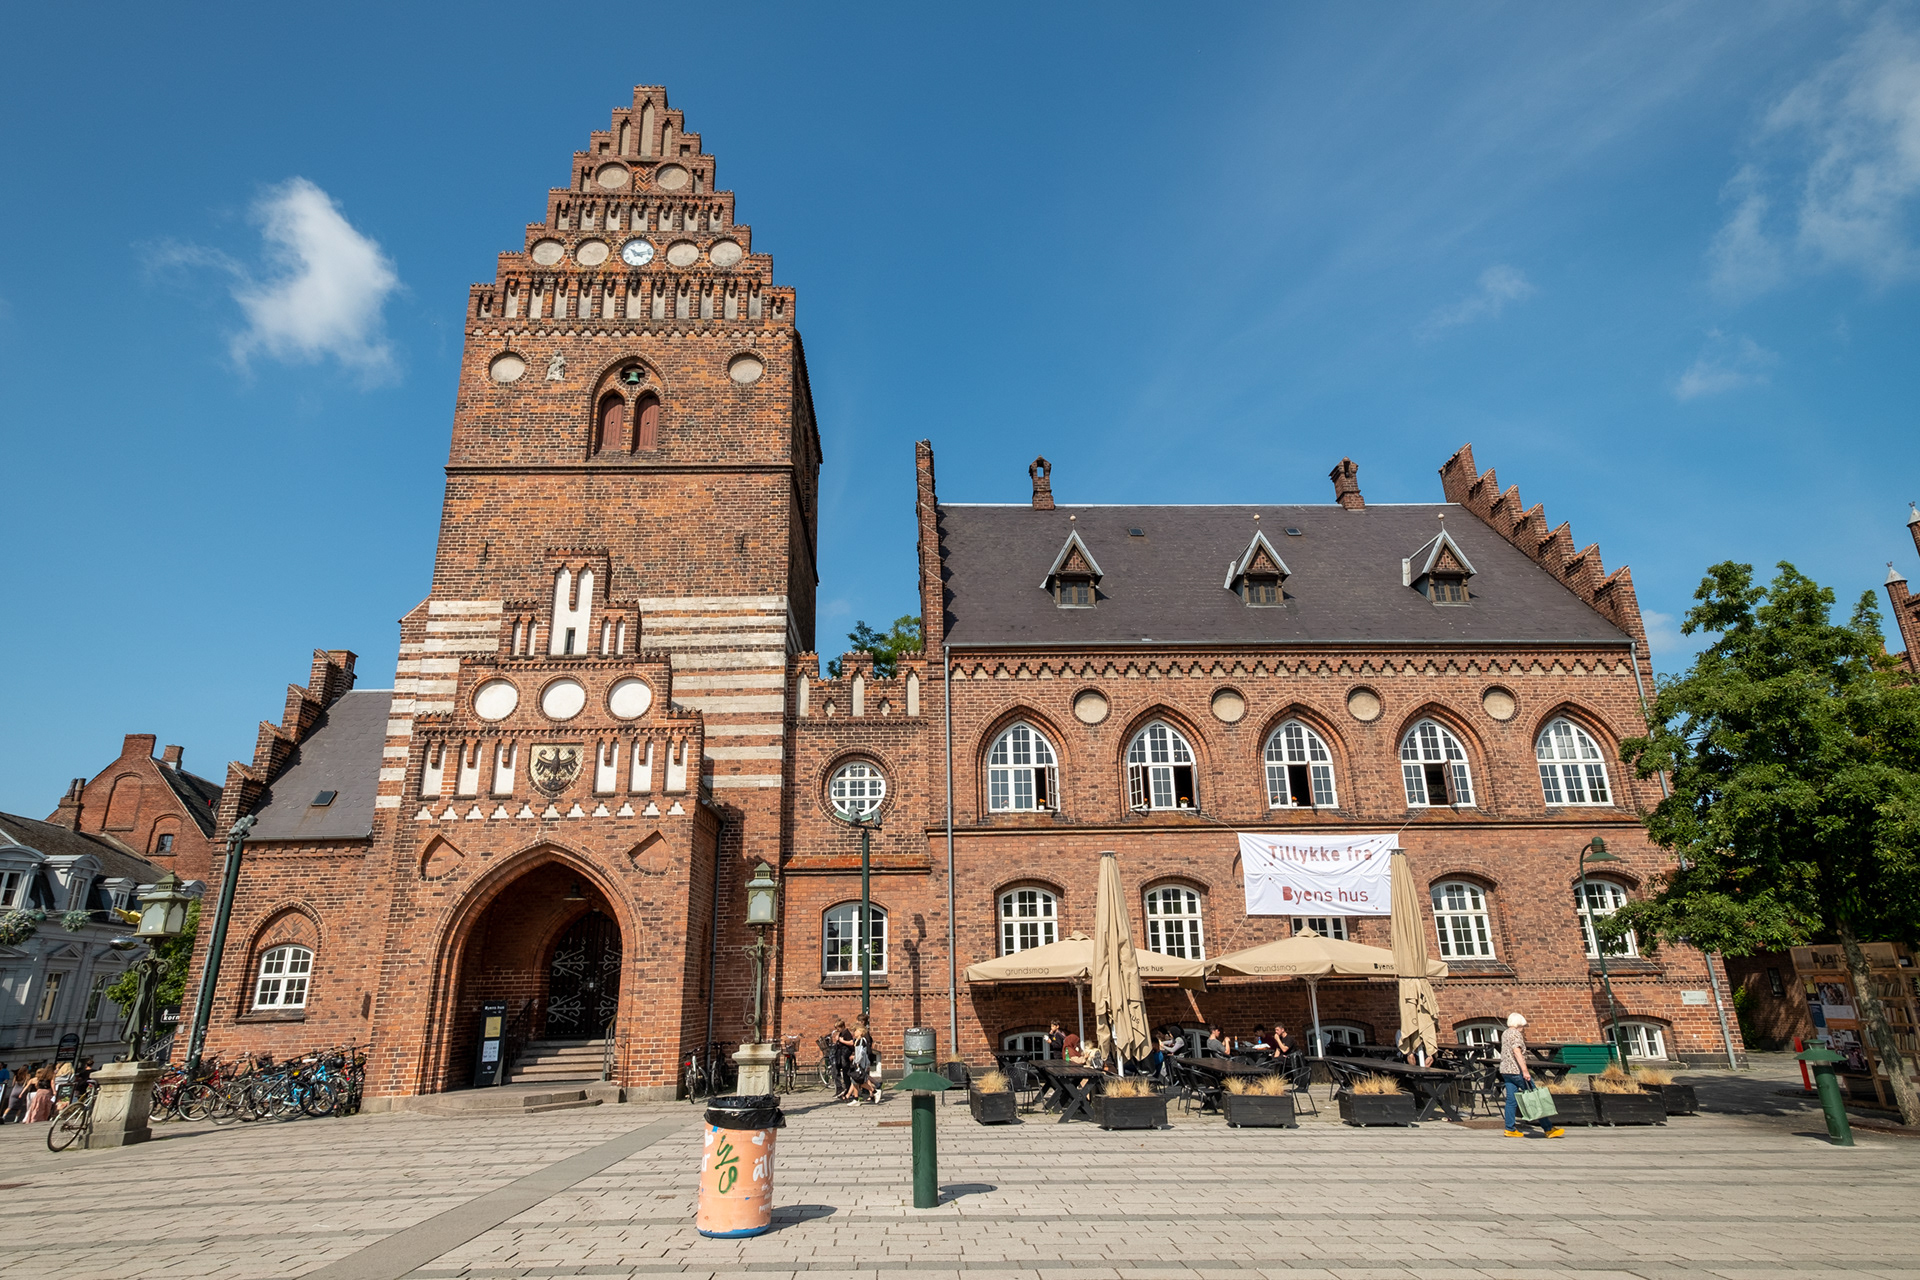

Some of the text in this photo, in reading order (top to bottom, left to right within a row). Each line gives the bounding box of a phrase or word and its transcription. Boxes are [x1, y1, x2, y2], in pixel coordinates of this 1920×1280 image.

[1268, 846, 1372, 864] Tillykke fra
[1282, 886, 1369, 905] Byens hus
[1374, 963, 1394, 971] Byens
[1811, 952, 1847, 966] Byens
